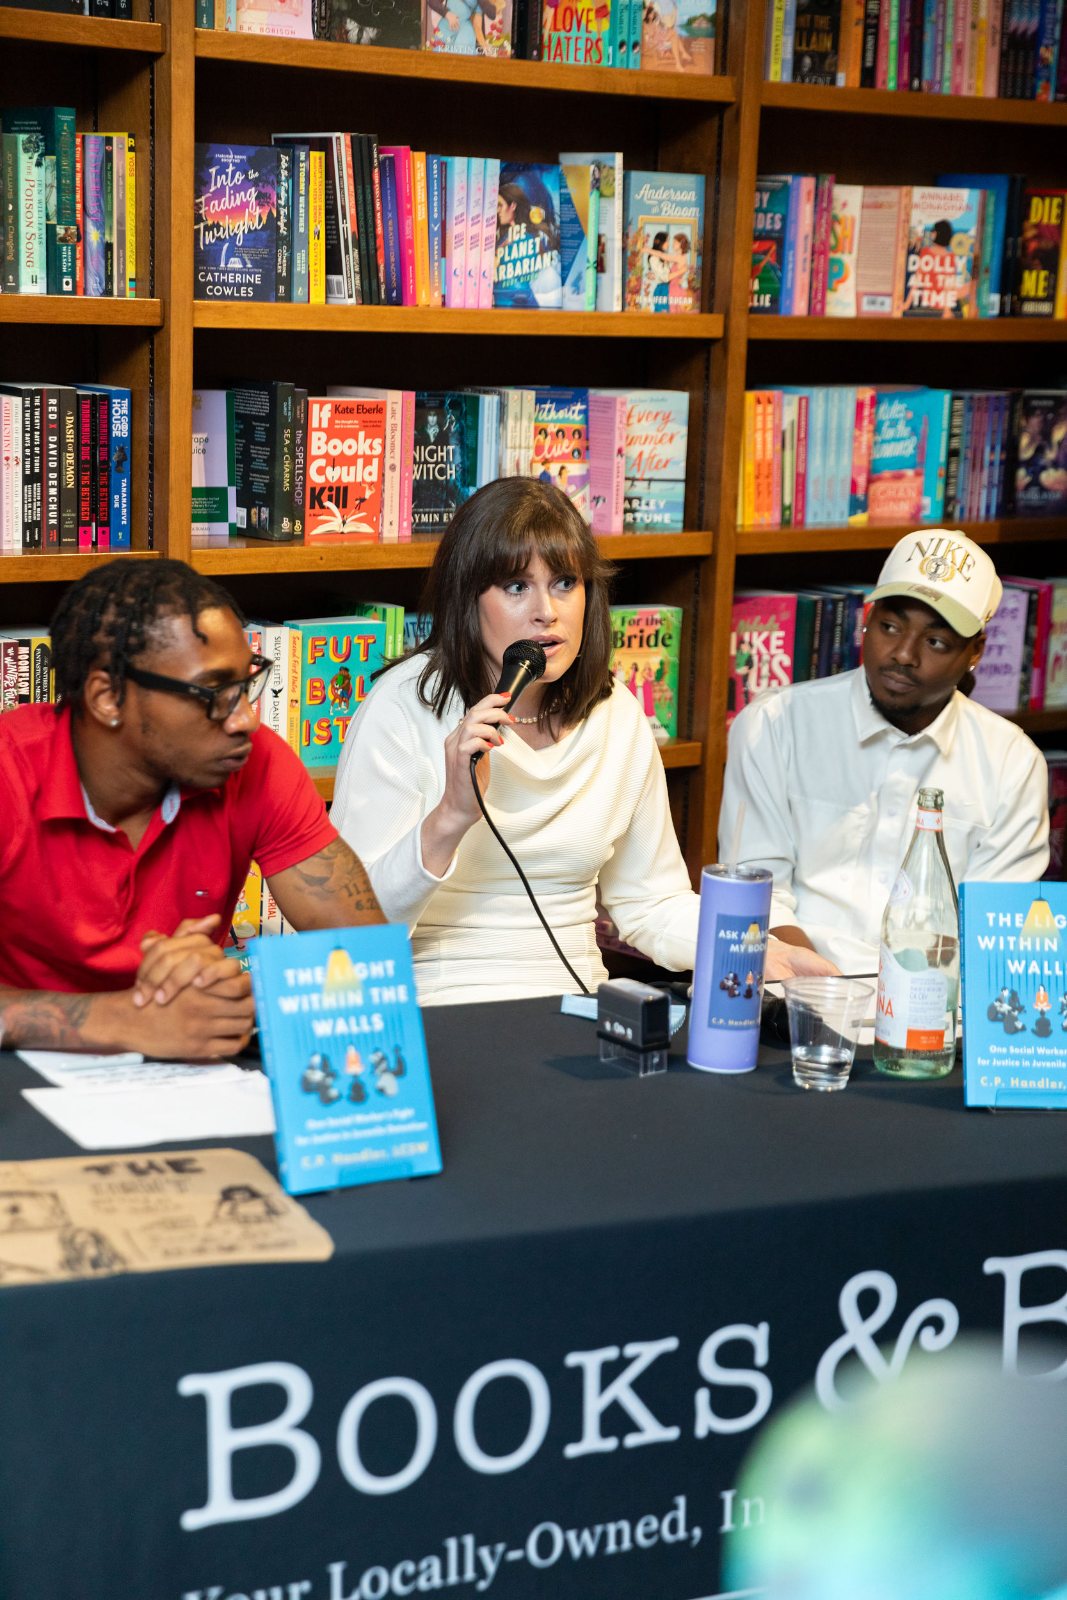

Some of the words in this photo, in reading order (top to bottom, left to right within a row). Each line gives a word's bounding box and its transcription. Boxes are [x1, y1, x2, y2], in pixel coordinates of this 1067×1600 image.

[553, 6, 593, 34] LOVE
[543, 34, 602, 65] HATERS
[300, 152, 305, 160] IN
[209, 164, 246, 192] Into
[248, 169, 260, 181] the
[25, 179, 35, 228] POISON
[196, 186, 258, 220] Fading
[634, 184, 697, 204] Anderson
[660, 201, 700, 216] Bloom
[1030, 196, 1062, 224] DIE
[194, 206, 263, 250] Twilight
[508, 223, 526, 242] ICE
[26, 232, 37, 268] SONG
[497, 237, 540, 262] PLANET
[908, 254, 968, 272] DOLLY
[198, 272, 262, 284] CATHERINE
[907, 274, 932, 287] ALL
[1020, 270, 1049, 297] ME
[206, 286, 253, 297] COWLES
[912, 290, 957, 308] TIME
[49, 399, 57, 420] RED
[82, 400, 90, 444] TANANARIVE
[100, 400, 108, 444] TANANARIVE
[112, 399, 120, 437] HOUSE
[312, 403, 332, 428] If
[334, 404, 355, 414] Kate
[356, 404, 383, 414] Eberle
[534, 398, 586, 421] ithout
[626, 403, 672, 431] Every
[66, 416, 74, 442] DASH
[192, 436, 209, 447] rape
[390, 423, 398, 460] Bloomer
[626, 431, 679, 447] ummer
[49, 436, 57, 468] DAVID
[82, 446, 90, 460] DUE
[100, 447, 108, 461] DUE
[311, 431, 382, 456] Books
[412, 446, 455, 462] NIGHT
[533, 434, 575, 459] Clue
[66, 453, 74, 488] DEMON
[295, 446, 304, 505] SPELLSHOP
[309, 458, 379, 484] Could
[412, 464, 456, 480] WITCH
[630, 450, 673, 480] After
[82, 472, 90, 485] THE
[100, 472, 108, 485] THE
[49, 473, 57, 525] DEMCHUK
[82, 487, 90, 521] BETWEEN
[100, 487, 108, 521] BETWEEN
[309, 486, 348, 510] Kill
[625, 498, 666, 510] ARLEY
[626, 512, 671, 524] RTUNE
[906, 538, 975, 582] NIKE
[621, 616, 641, 627] For
[645, 615, 665, 626] the
[308, 634, 376, 664] FUT
[613, 629, 673, 648] Bride
[4, 657, 18, 687] WINTER
[18, 647, 30, 695] MOONFLOW
[4, 688, 17, 705] FOLK
[306, 675, 369, 705] BOL
[302, 716, 353, 746] IST
[268, 895, 276, 920] ERIAL
[986, 912, 1023, 928] THE
[1034, 914, 1067, 929] LIG
[718, 929, 738, 940] ASK
[977, 935, 1058, 952] WITHIN
[729, 943, 745, 952] MY
[748, 943, 767, 953] BOO
[284, 966, 326, 987] THE
[335, 960, 396, 982] LIGHT
[1008, 960, 1065, 976] WALL
[278, 989, 364, 1014] WITHIN
[369, 984, 409, 1005] THE
[312, 1013, 384, 1038] WALLS
[977, 1057, 990, 1066] for
[992, 1058, 1020, 1067] Justice
[1022, 1058, 1030, 1068] in
[1032, 1059, 1066, 1069] Juvenile
[989, 1045, 1007, 1054] One
[1009, 1045, 1034, 1055] Social
[1037, 1046, 1067, 1056] Worker
[980, 1076, 1006, 1088] C.P.
[1010, 1077, 1066, 1090] Handler,
[83, 1158, 203, 1176] THE
[177, 1321, 773, 1532] BOOKS
[814, 1270, 960, 1418] &
[983, 1249, 1067, 1384] B
[327, 1495, 702, 1600] Locally-Owned,
[720, 1489, 766, 1535] In
